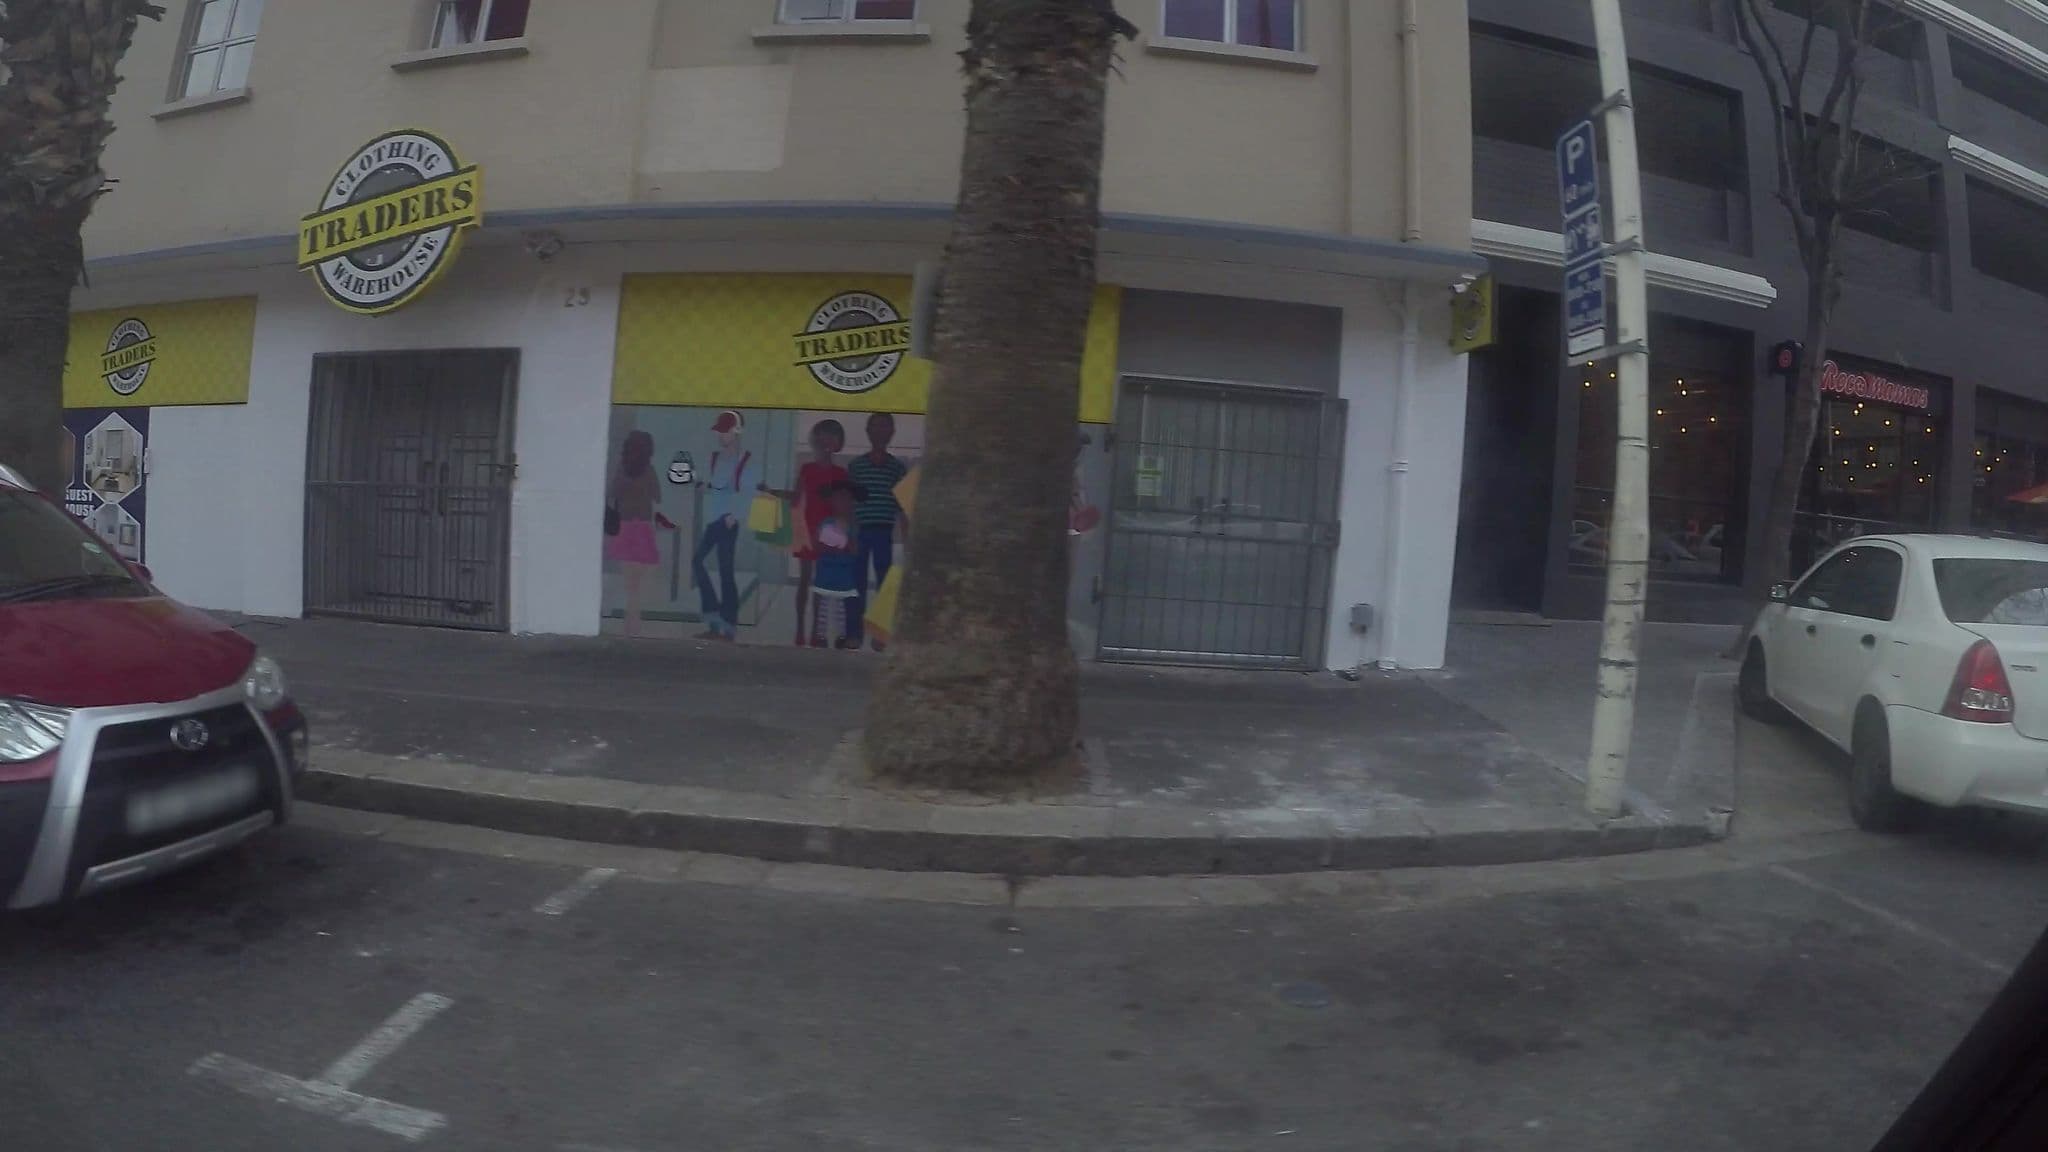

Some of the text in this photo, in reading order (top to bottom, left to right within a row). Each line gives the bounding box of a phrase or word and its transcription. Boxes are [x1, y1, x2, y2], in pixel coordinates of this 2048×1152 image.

[335, 141, 441, 197] CLOTHING
[1566, 136, 1585, 174] P
[304, 179, 474, 255] TRADERS
[331, 236, 439, 296] WAREHOUSE
[103, 341, 156, 371] TRADERS
[795, 325, 912, 358] TRADERS
